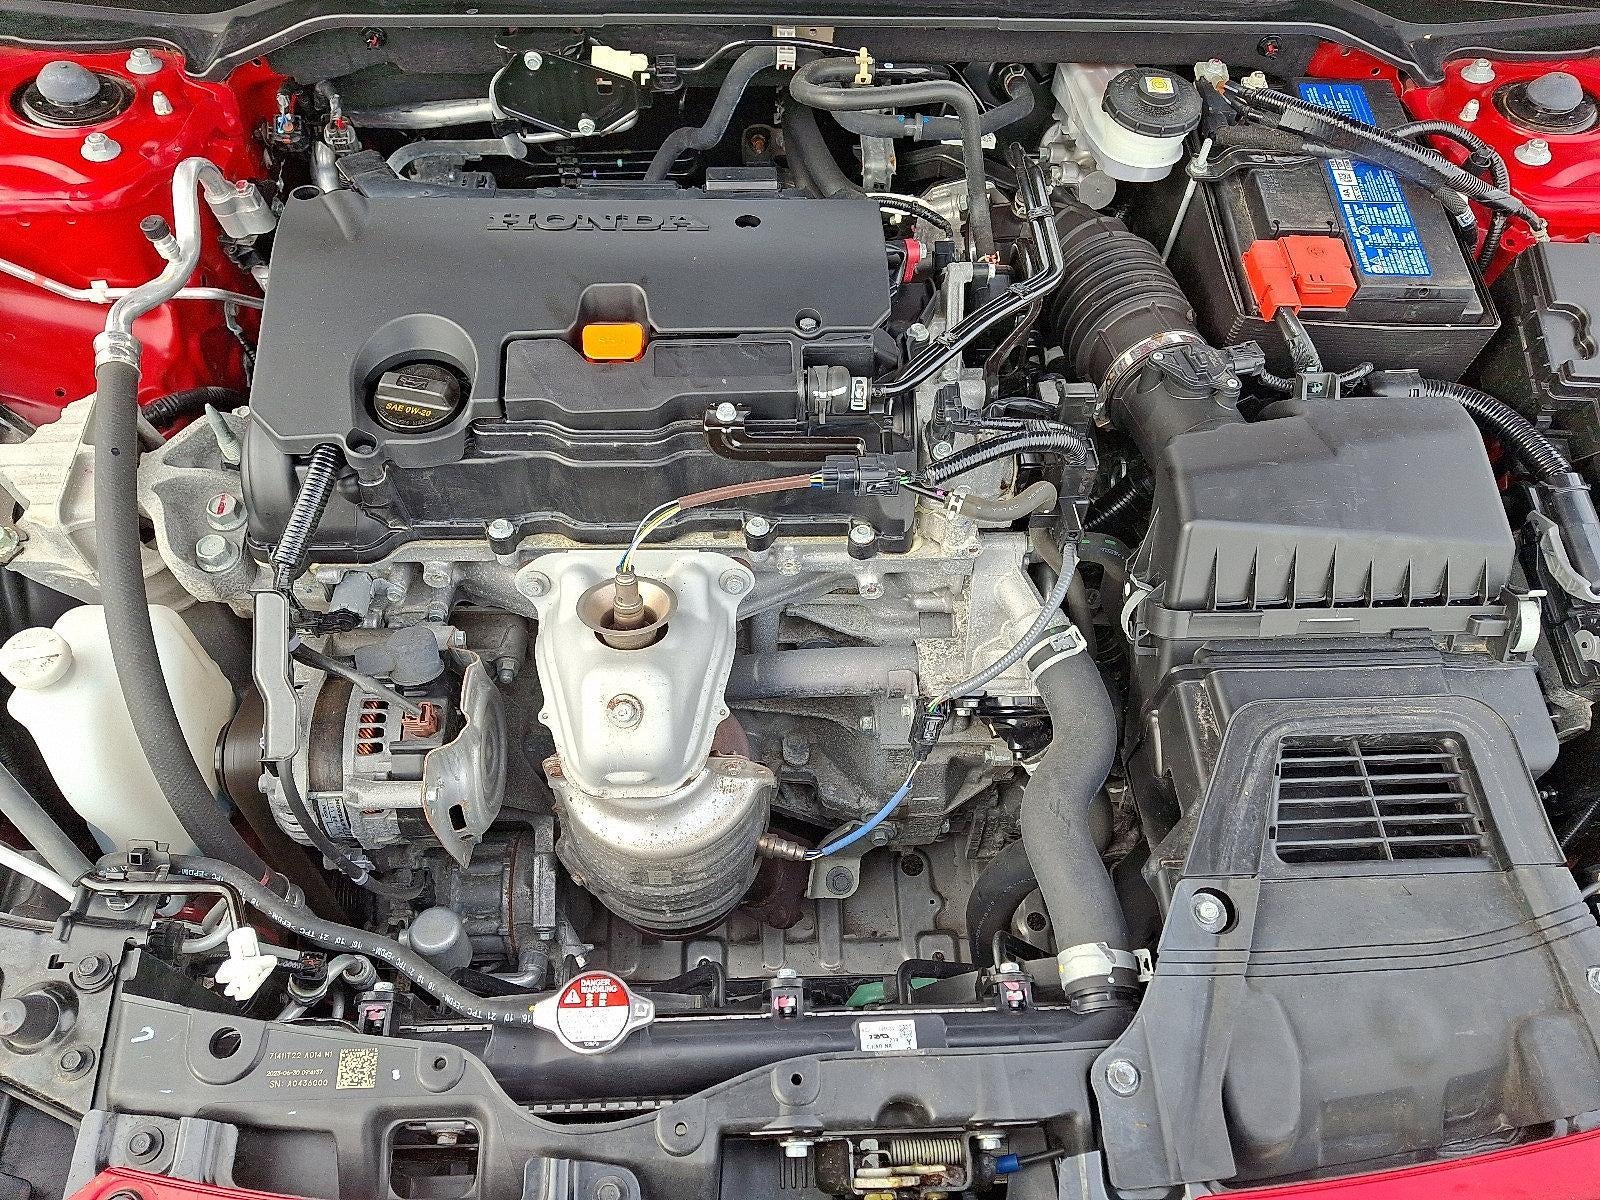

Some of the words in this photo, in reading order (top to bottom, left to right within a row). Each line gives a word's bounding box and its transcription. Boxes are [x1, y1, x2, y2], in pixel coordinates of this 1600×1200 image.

[487, 212, 709, 232] HONDA
[385, 403, 404, 412] SAE
[405, 406, 432, 417] 0W-20
[299, 927, 316, 938] TPC
[581, 985, 618, 993] WARNING
[466, 1007, 483, 1019] TPC
[269, 1080, 284, 1089] SN:
